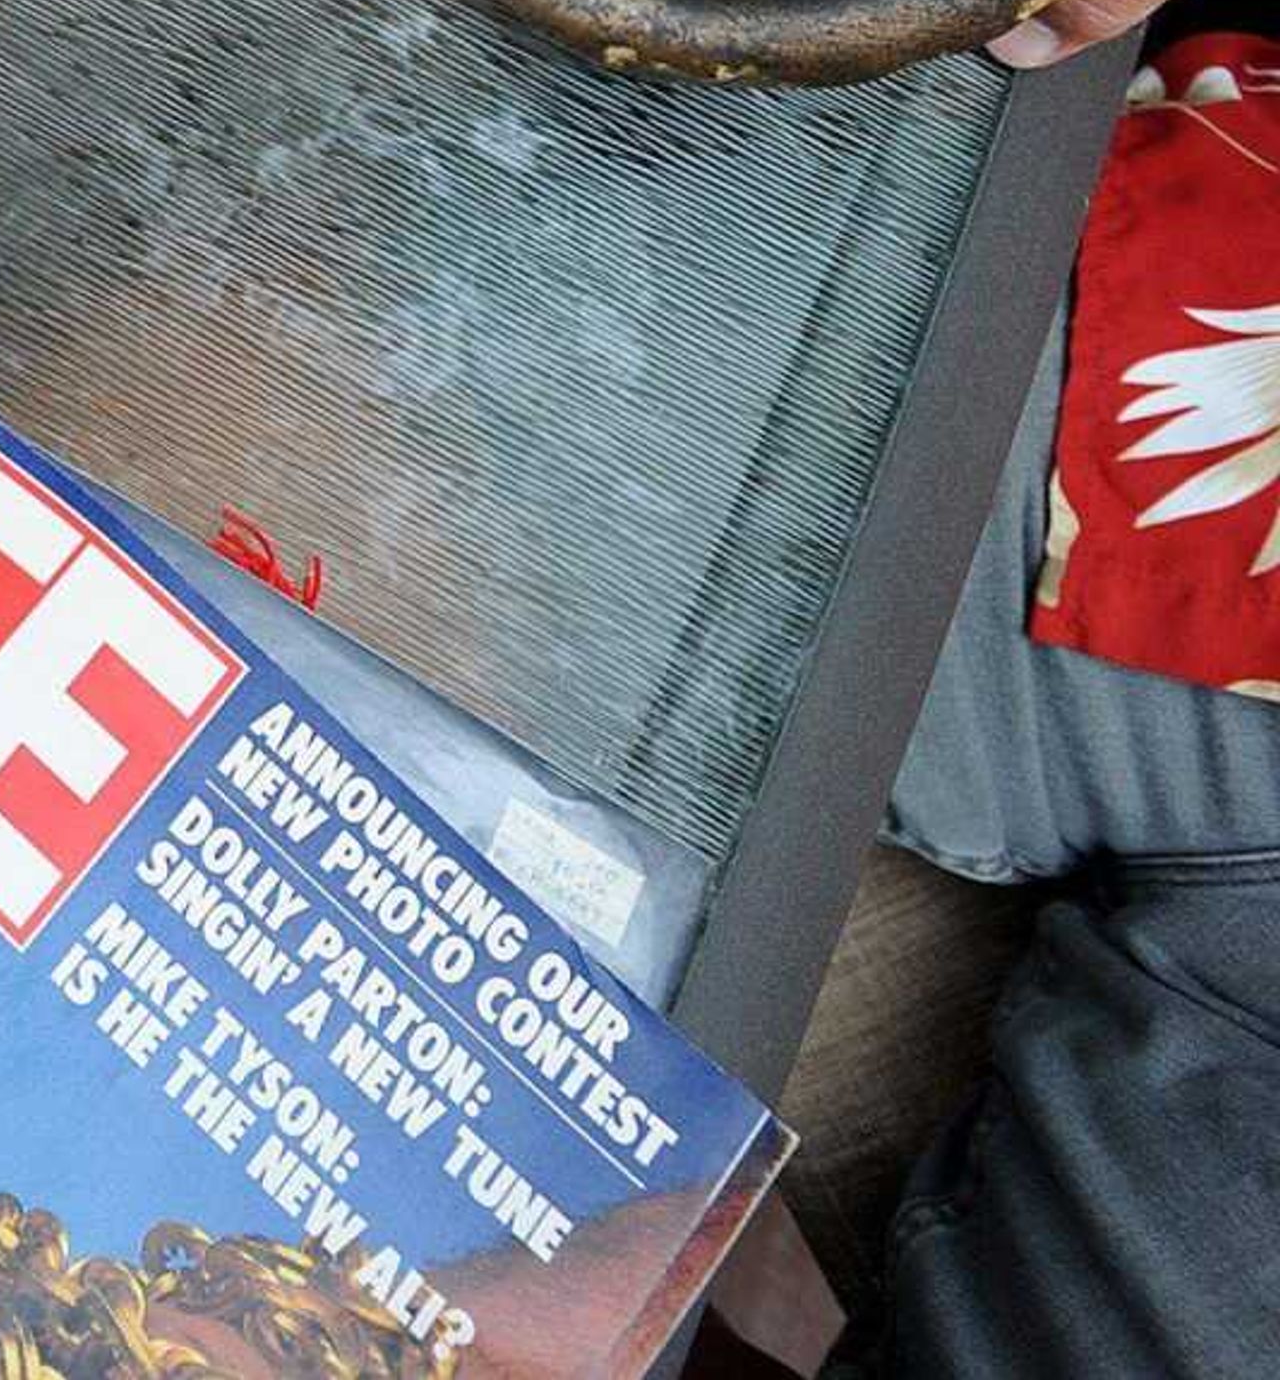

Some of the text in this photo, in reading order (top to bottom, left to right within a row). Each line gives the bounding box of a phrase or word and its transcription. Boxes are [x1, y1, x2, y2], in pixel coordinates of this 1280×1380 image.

[86, 902, 360, 1184] MIKE TYSON:
[137, 841, 574, 1263] SINGIN' A NEW TUNE
[169, 796, 308, 928] DOLLY
[299, 921, 492, 1117] PARTON:
[217, 736, 331, 851] NEW
[320, 832, 474, 984] PHOTO
[476, 979, 679, 1167] CONTEST
[249, 702, 528, 961] ANNOUNCING
[529, 952, 630, 1059] OUR
[51, 943, 476, 1358] IS HE THE NEW ALI?
